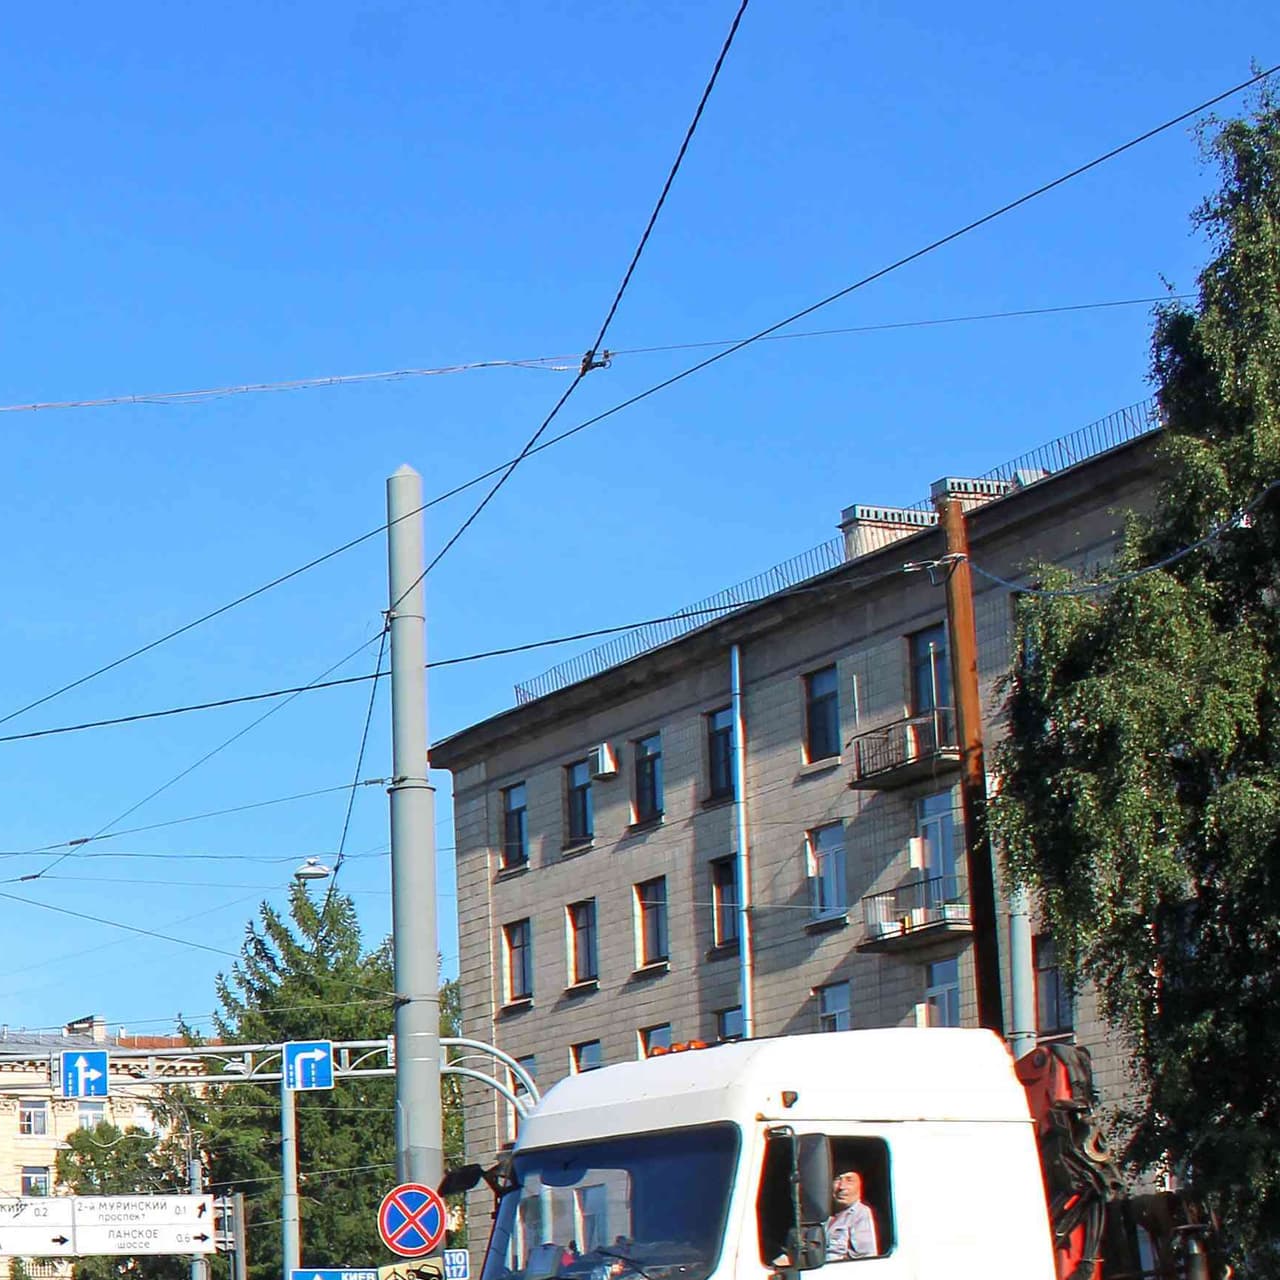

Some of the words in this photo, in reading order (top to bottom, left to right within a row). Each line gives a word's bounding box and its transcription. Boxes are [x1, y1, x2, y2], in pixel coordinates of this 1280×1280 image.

[98, 1199, 168, 1211] МУРИНСКИЙ
[98, 1212, 146, 1222] проспект
[107, 1229, 159, 1239] ЛАНСКОЕ
[117, 1240, 151, 1249] шоссе
[444, 1252, 466, 1265] 110
[444, 1265, 466, 1278] 117
